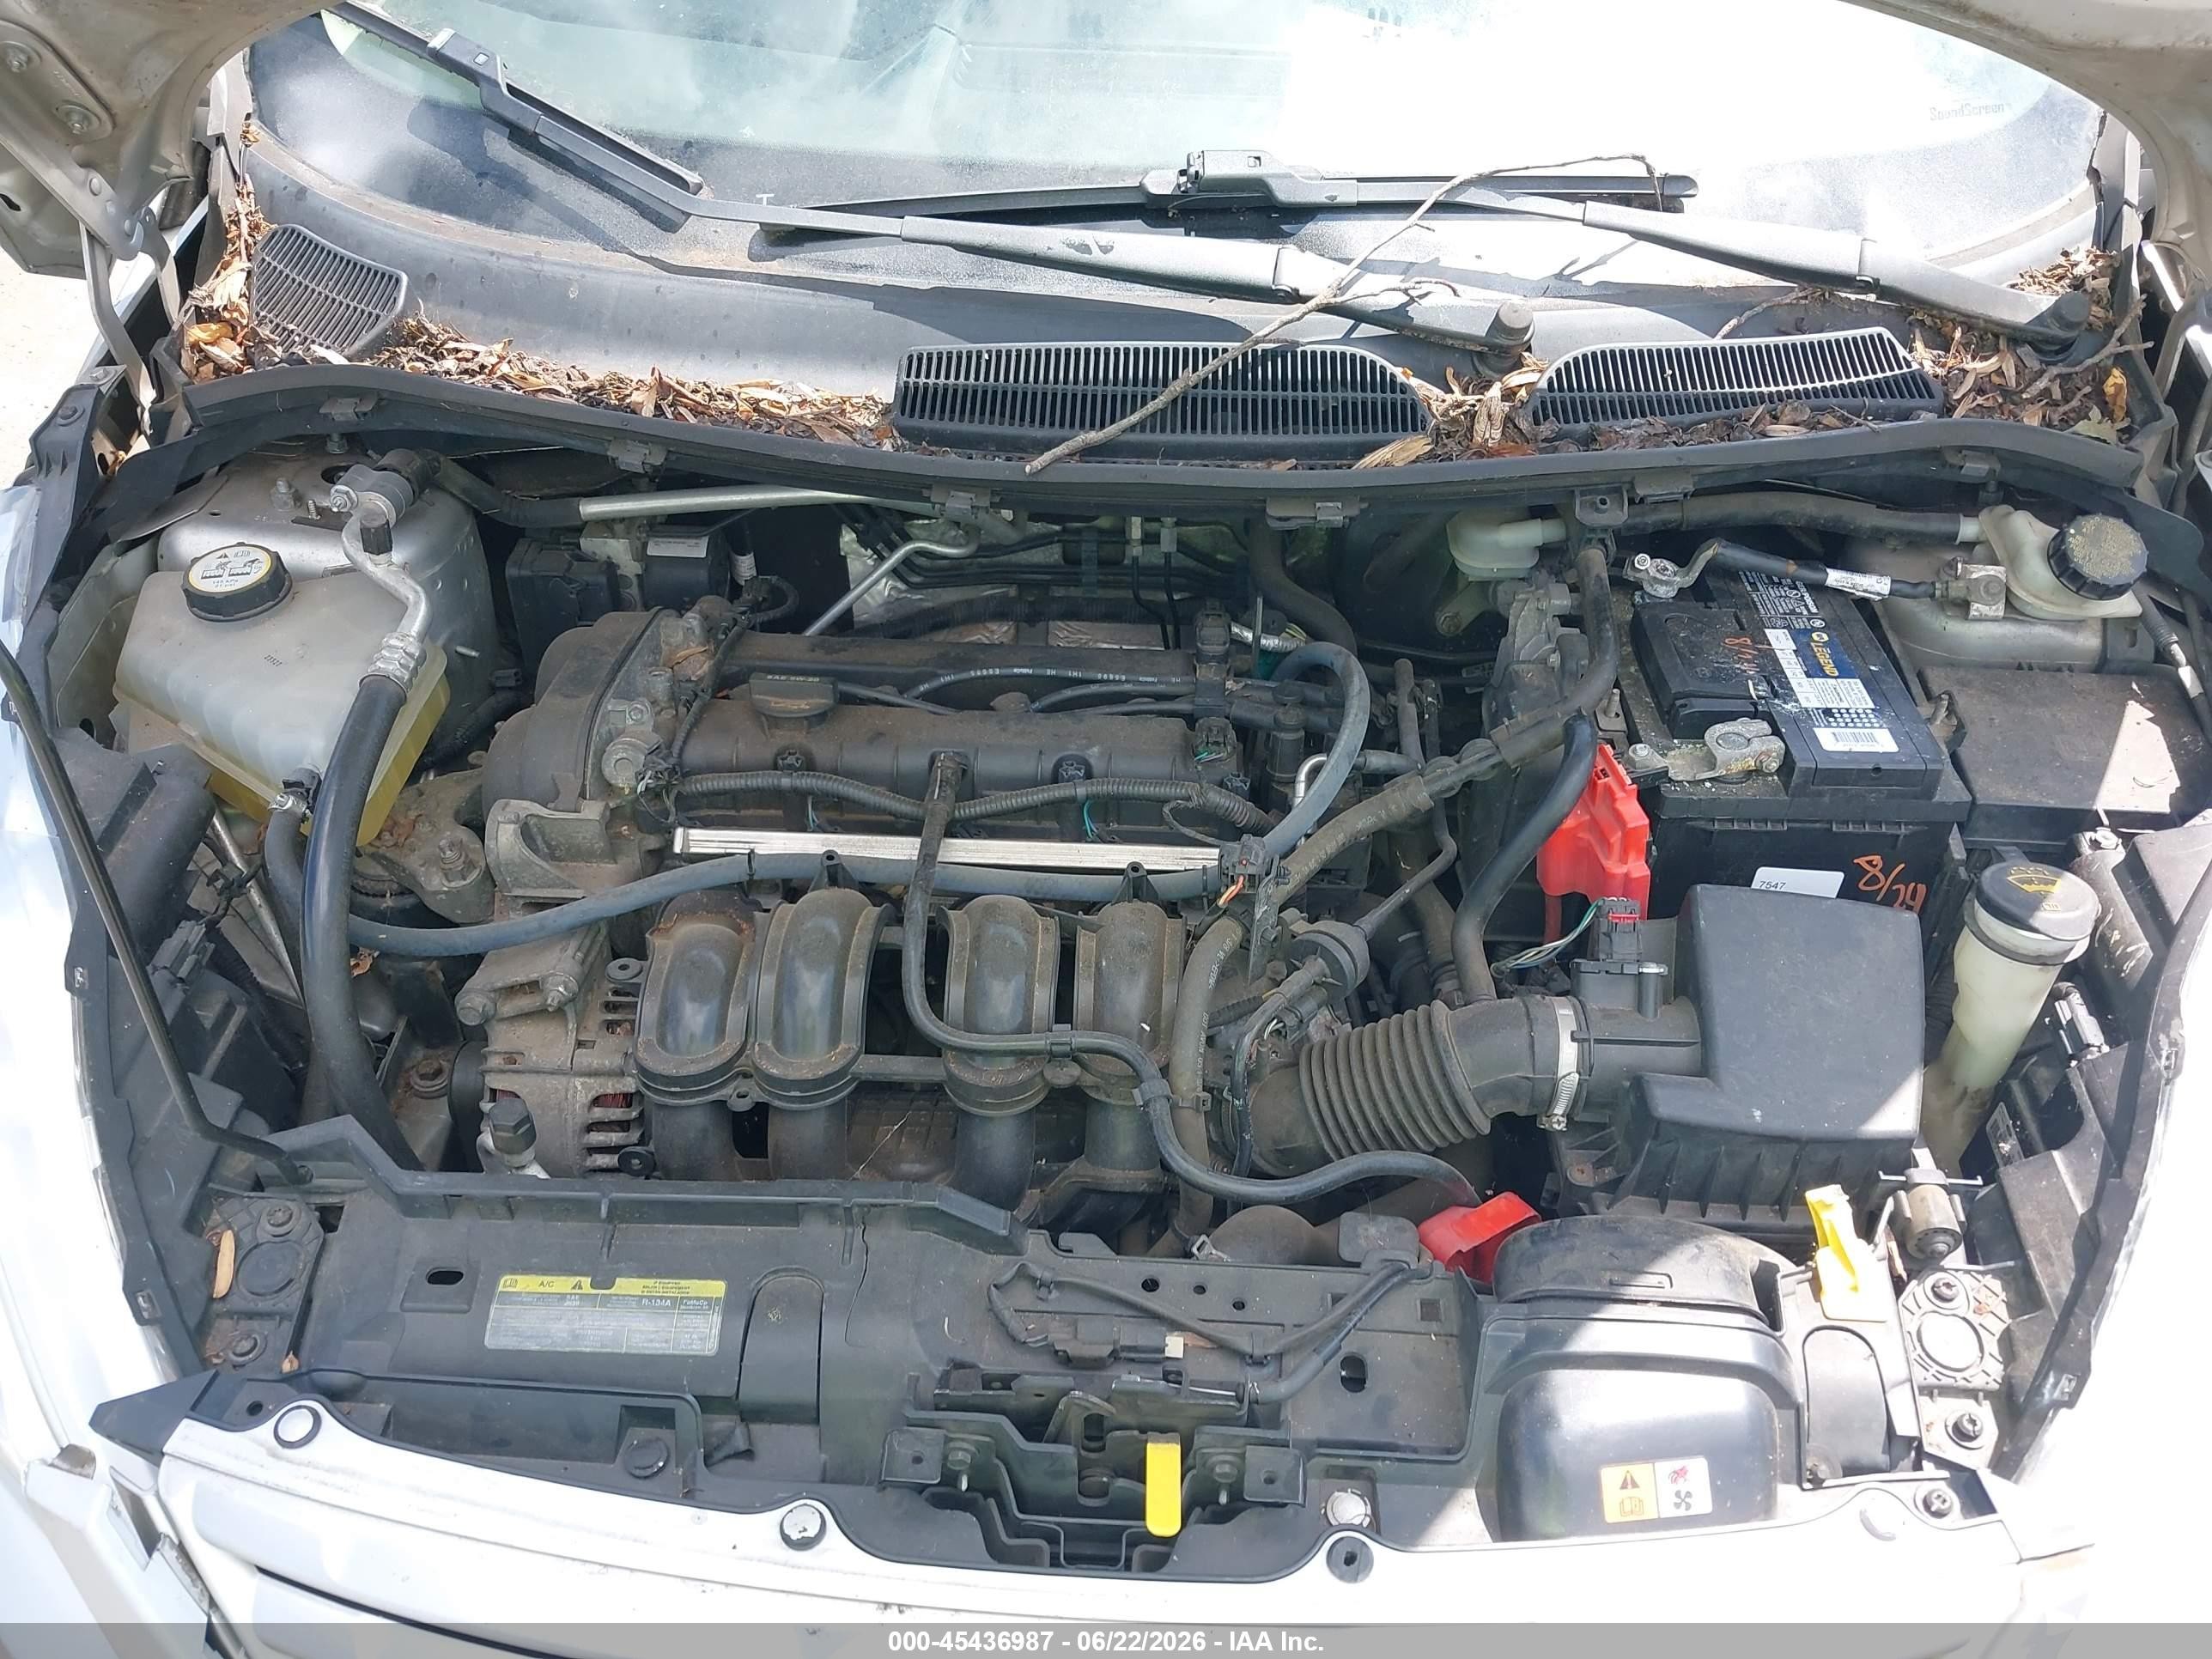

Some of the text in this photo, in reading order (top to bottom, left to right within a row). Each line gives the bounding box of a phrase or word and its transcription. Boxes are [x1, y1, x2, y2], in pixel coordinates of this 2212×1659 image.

[1929, 102, 2004, 121] SoundScreen
[1809, 641, 1840, 677] LEGEND
[1759, 880, 1786, 890] 7547
[538, 1279, 555, 1289] A/C
[641, 1297, 672, 1308] R-134A
